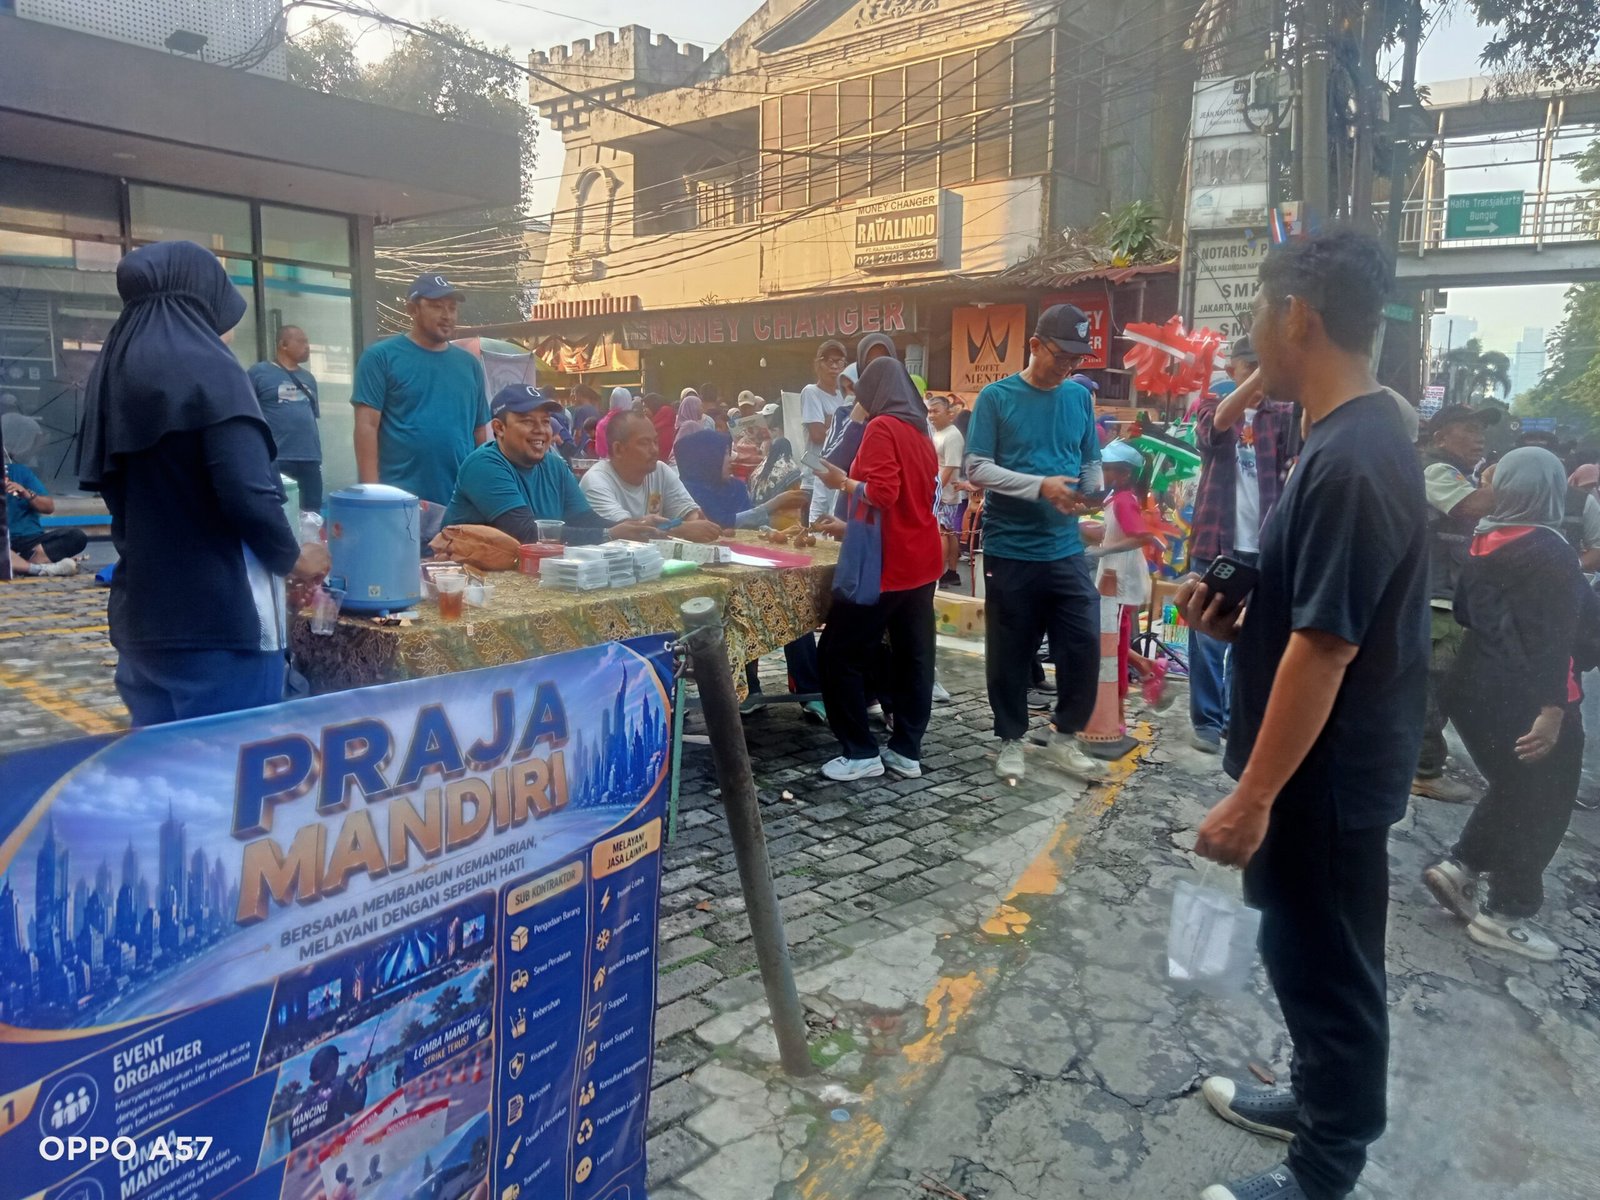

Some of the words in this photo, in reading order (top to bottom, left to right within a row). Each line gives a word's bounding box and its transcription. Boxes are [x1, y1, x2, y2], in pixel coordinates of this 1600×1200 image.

[858, 202, 889, 215] MONEY
[891, 195, 935, 210] CHANGER
[1451, 199, 1470, 208] Halte
[1474, 196, 1521, 208] Transjakarta
[857, 214, 935, 244] RAVALINDO
[1469, 211, 1498, 222] Bungur
[857, 255, 875, 265] 021
[878, 252, 904, 264] 2708
[907, 248, 934, 260] 3333
[1202, 245, 1248, 260] NOTARIS
[1199, 303, 1233, 313] JAKARTA
[650, 316, 741, 345] MONEY
[753, 301, 906, 341] CHANGER
[231, 680, 570, 841] PRAJA
[235, 750, 570, 927] MANDIRI
[612, 832, 645, 854] MELAYANI
[607, 856, 625, 870] JASA
[281, 907, 358, 948] BERSAMA
[362, 868, 452, 918] MEMBANGUN
[455, 836, 537, 878] KEMANDIRIAN,
[515, 889, 531, 906] SUB
[532, 869, 576, 897] KONTRAKTOR
[299, 919, 378, 961] MELAYANI
[382, 894, 440, 928] DENGAN
[443, 871, 497, 901] SEPENUH
[500, 856, 525, 880] HATI
[533, 914, 562, 935] Pengadaan
[563, 906, 581, 921] Barang
[533, 963, 548, 976] Sewa
[413, 1039, 443, 1061] LOMBA
[445, 1013, 481, 1044] MANCING
[600, 1038, 614, 1052] Event
[614, 1026, 634, 1043] Support
[113, 1034, 165, 1073] EVENT
[114, 1039, 202, 1093] ORGANIZER
[423, 1051, 446, 1068] STRIKE
[3, 1099, 15, 1126] 1
[115, 1103, 148, 1125] dengan
[149, 1089, 180, 1108] konsep
[292, 1100, 328, 1127] MANCING
[117, 1123, 133, 1137] dan
